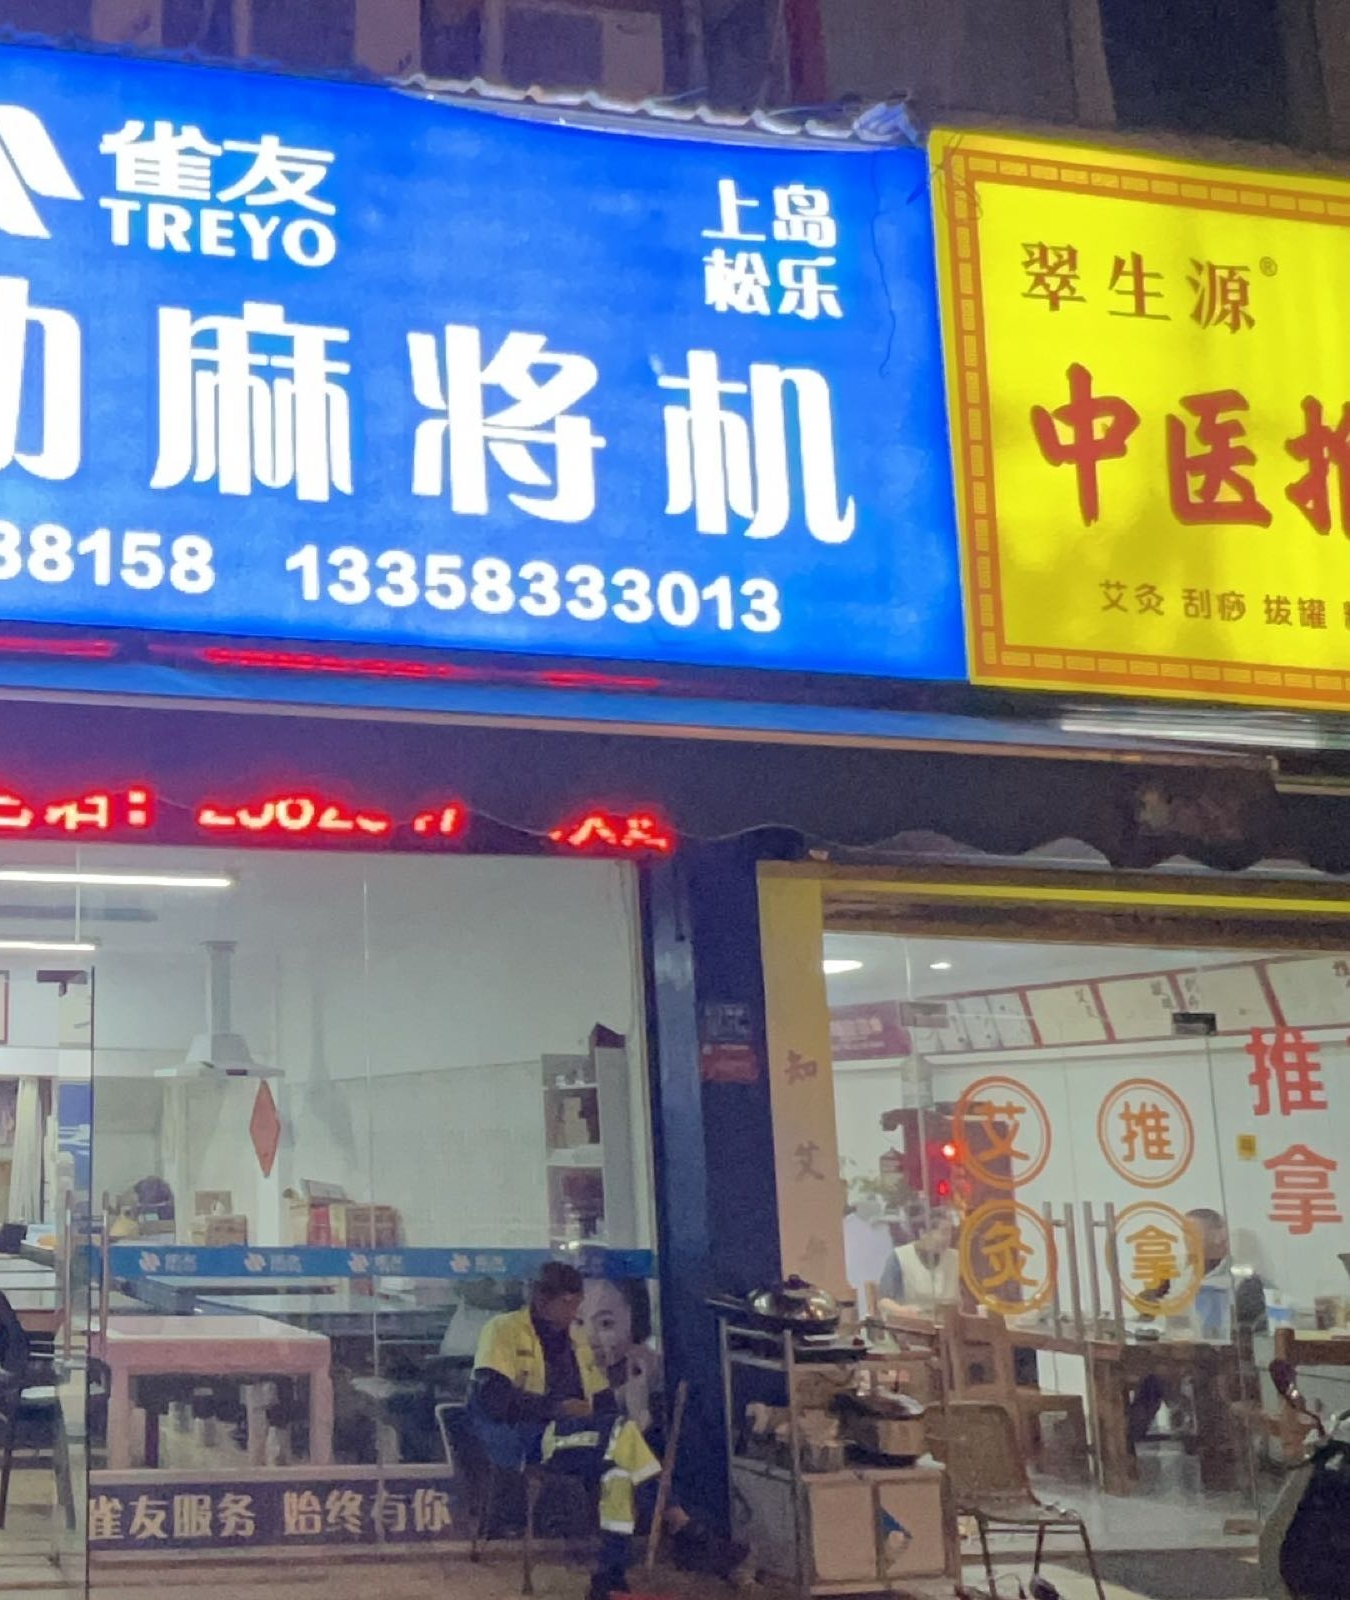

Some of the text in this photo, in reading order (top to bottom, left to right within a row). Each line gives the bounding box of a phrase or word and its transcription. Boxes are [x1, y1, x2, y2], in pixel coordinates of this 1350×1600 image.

[100, 120, 336, 216] 雀友
[100, 199, 337, 268] TREYO
[702, 179, 837, 249] 上岛
[702, 248, 843, 321] 松乐
[1020, 241, 1256, 335] 翠生源
[284, 544, 782, 633] 13358333013
[1244, 1027, 1343, 1235] 推拿
[89, 1488, 452, 1540] 雀友服务 始终有你
